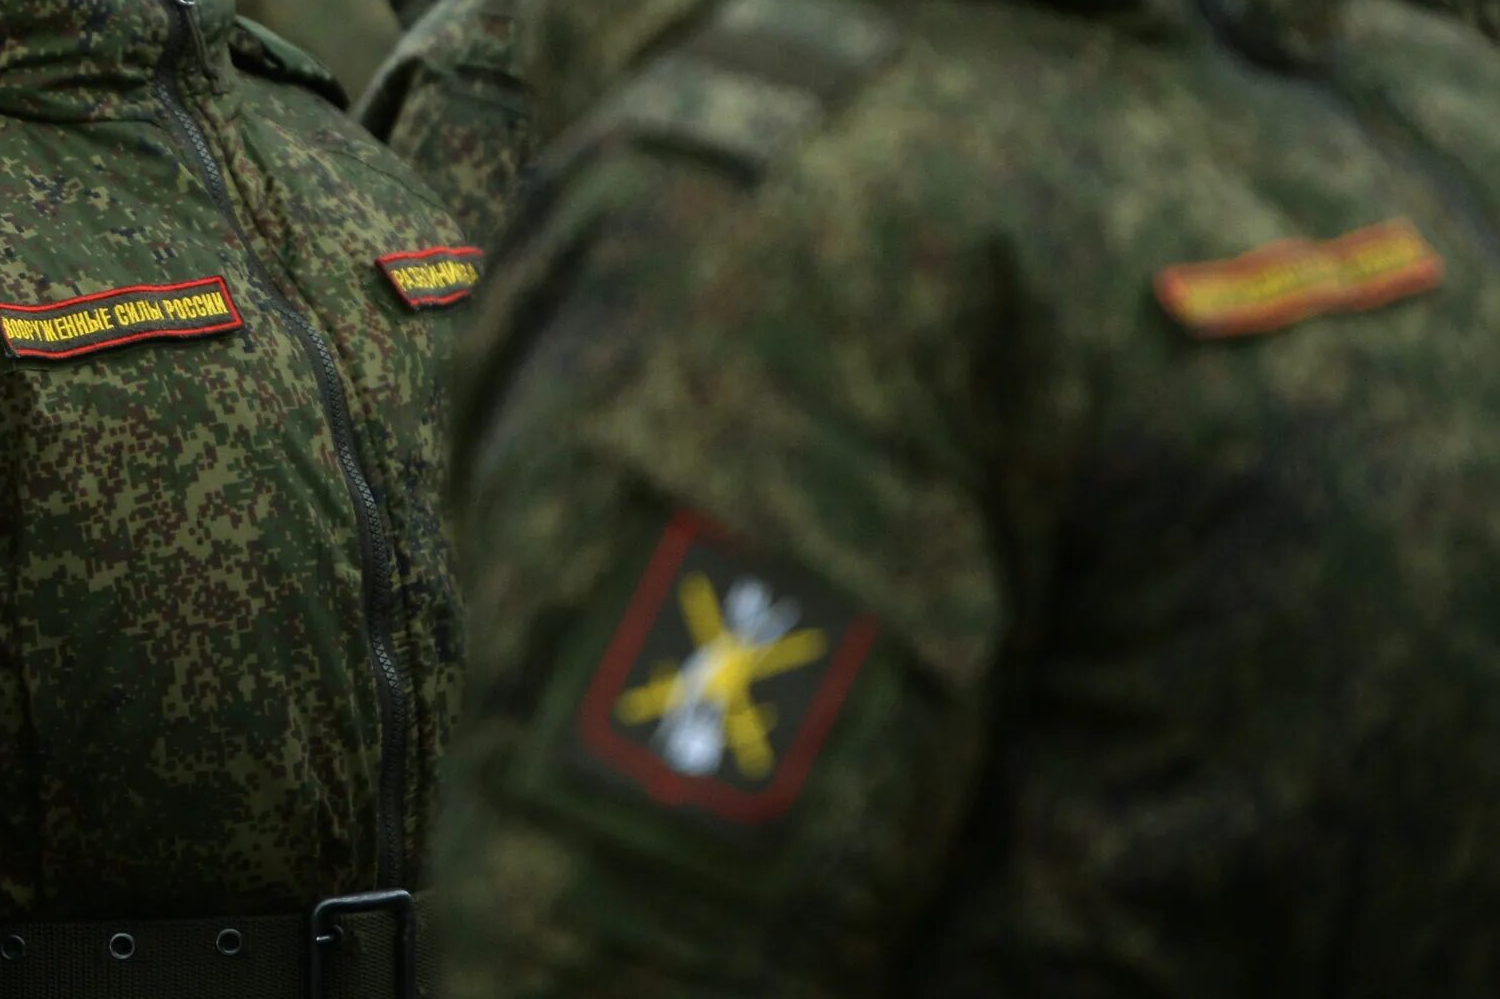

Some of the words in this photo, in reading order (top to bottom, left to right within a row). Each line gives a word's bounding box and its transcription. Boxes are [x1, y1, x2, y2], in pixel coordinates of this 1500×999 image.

[1, 307, 114, 343] ВООРУЖЕННЫЕ
[113, 299, 164, 326] СИЛЫ
[162, 291, 229, 320] РОССИИ
